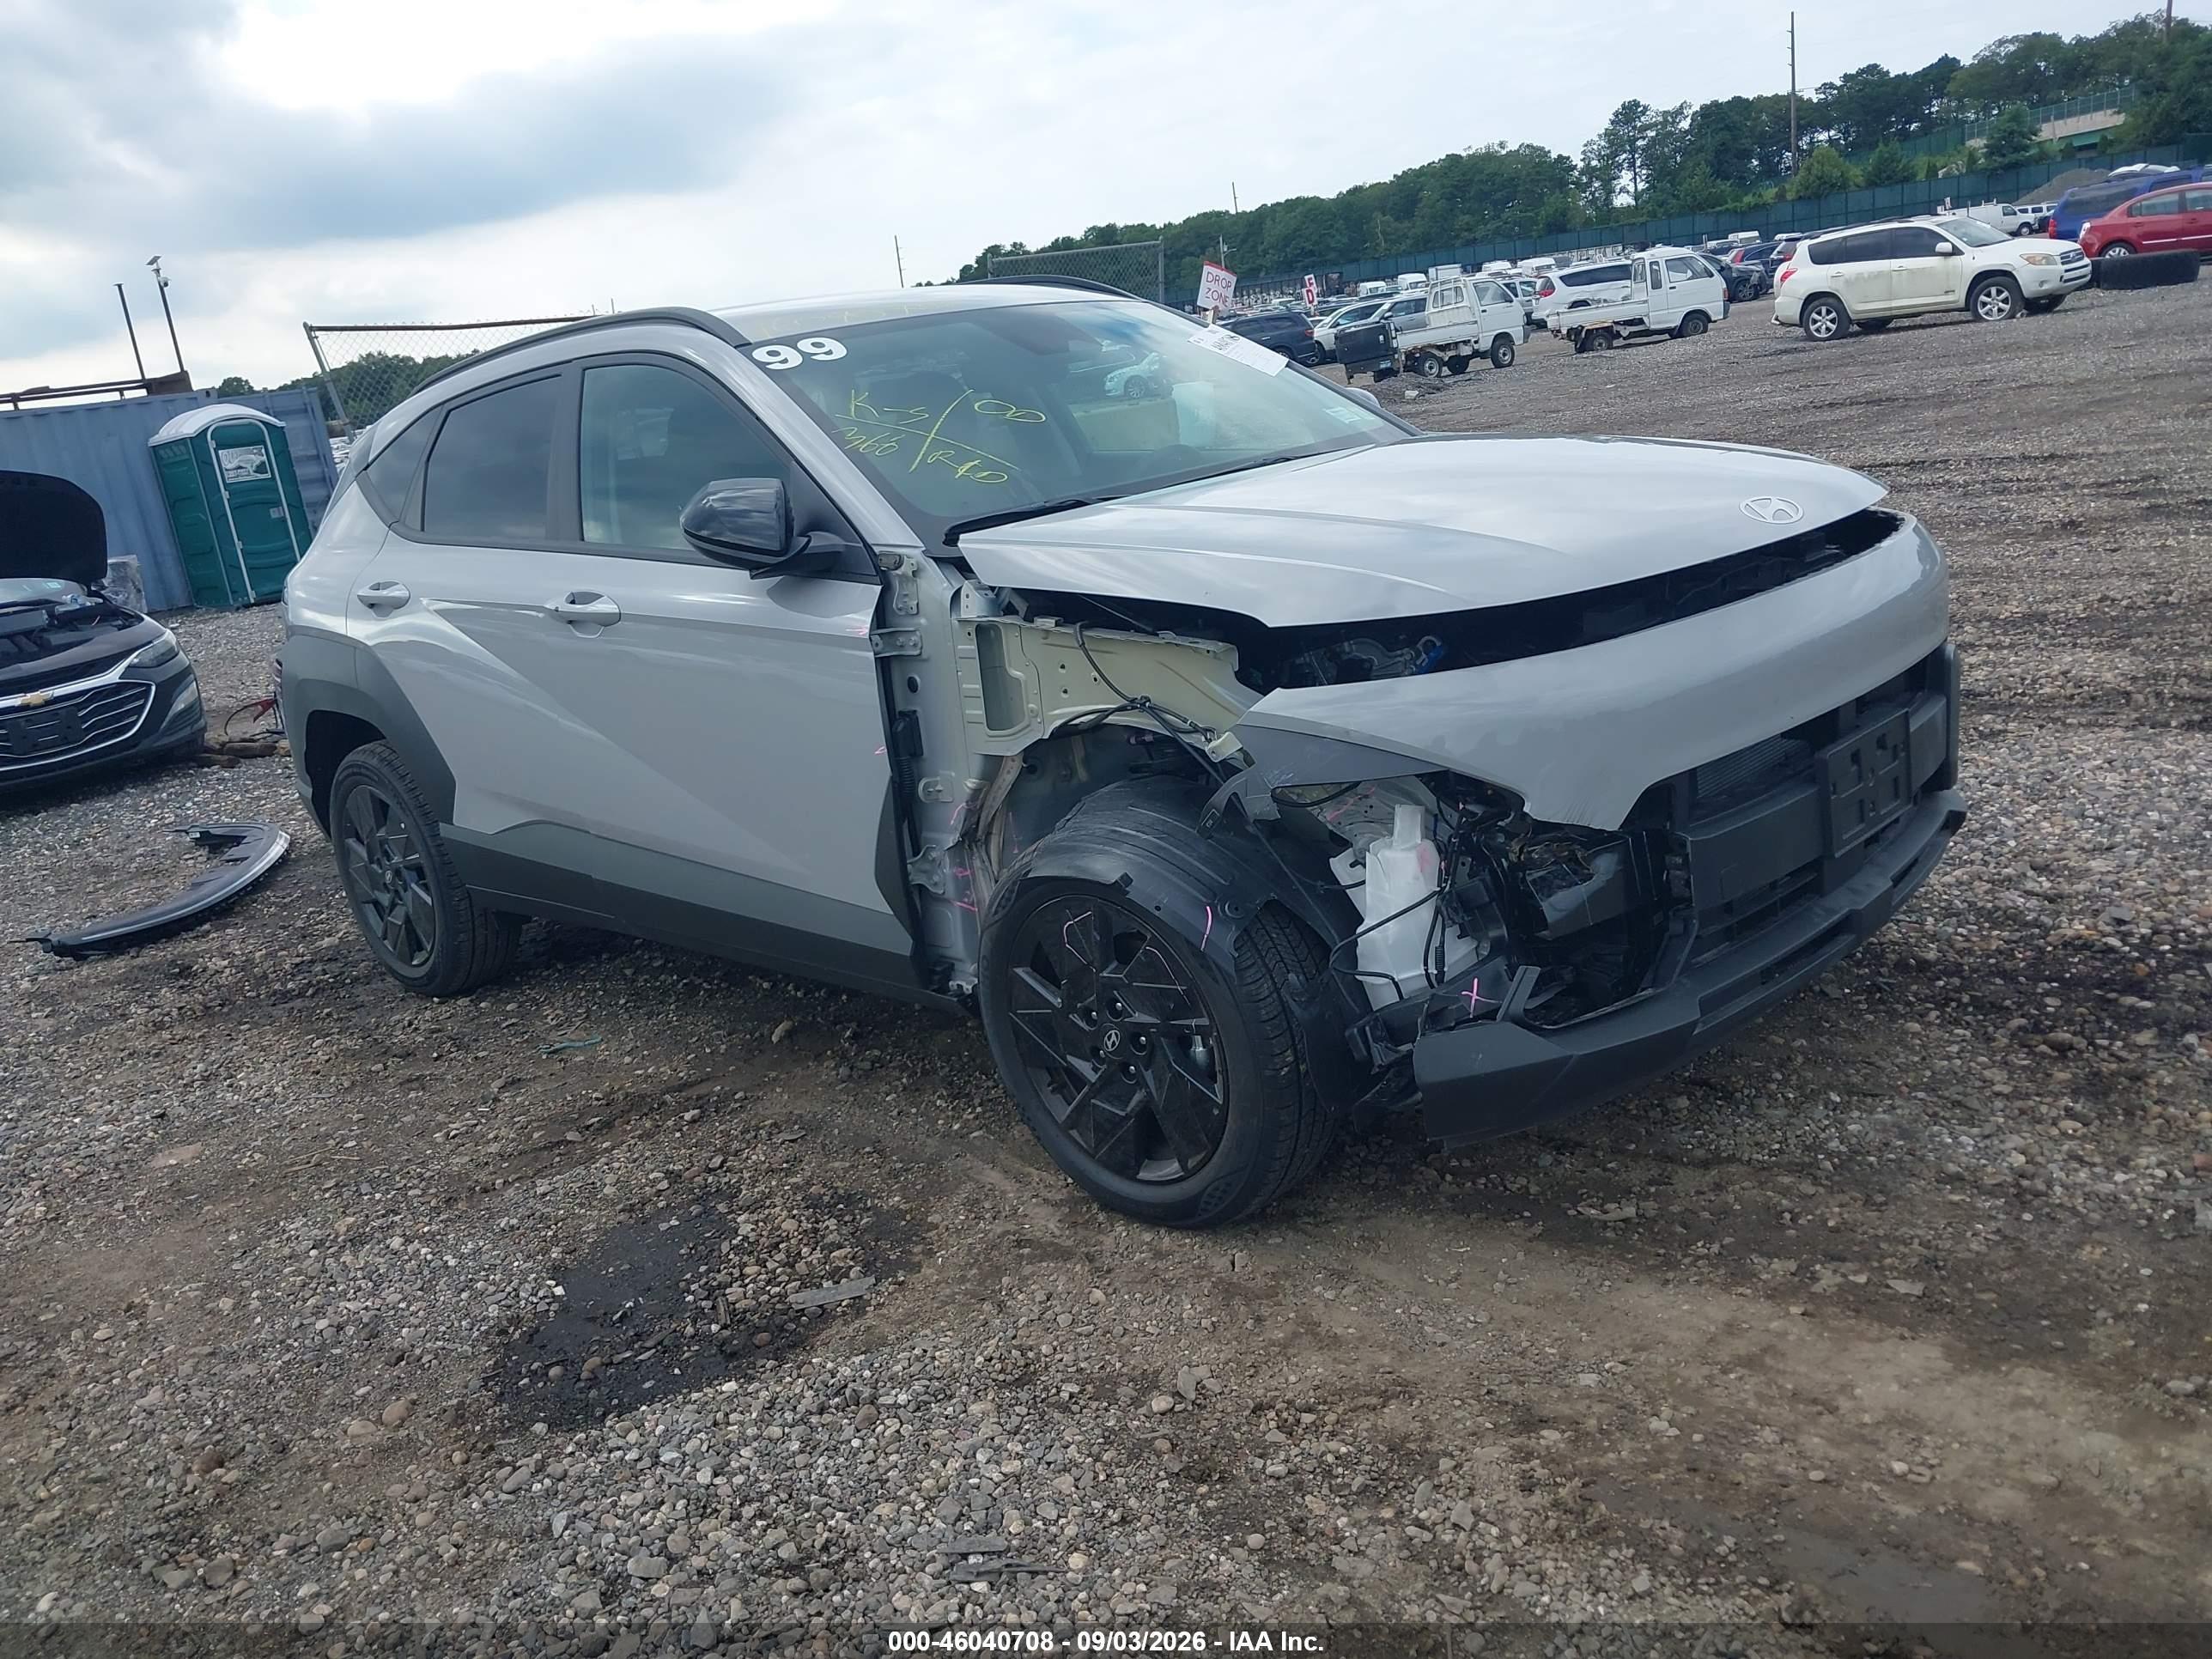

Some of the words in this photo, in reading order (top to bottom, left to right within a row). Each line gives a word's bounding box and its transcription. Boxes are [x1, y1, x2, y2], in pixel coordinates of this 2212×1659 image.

[1206, 271, 1232, 291] DROP
[1205, 287, 1230, 308] ZONE
[1305, 289, 1316, 305] D
[751, 337, 848, 370] 99
